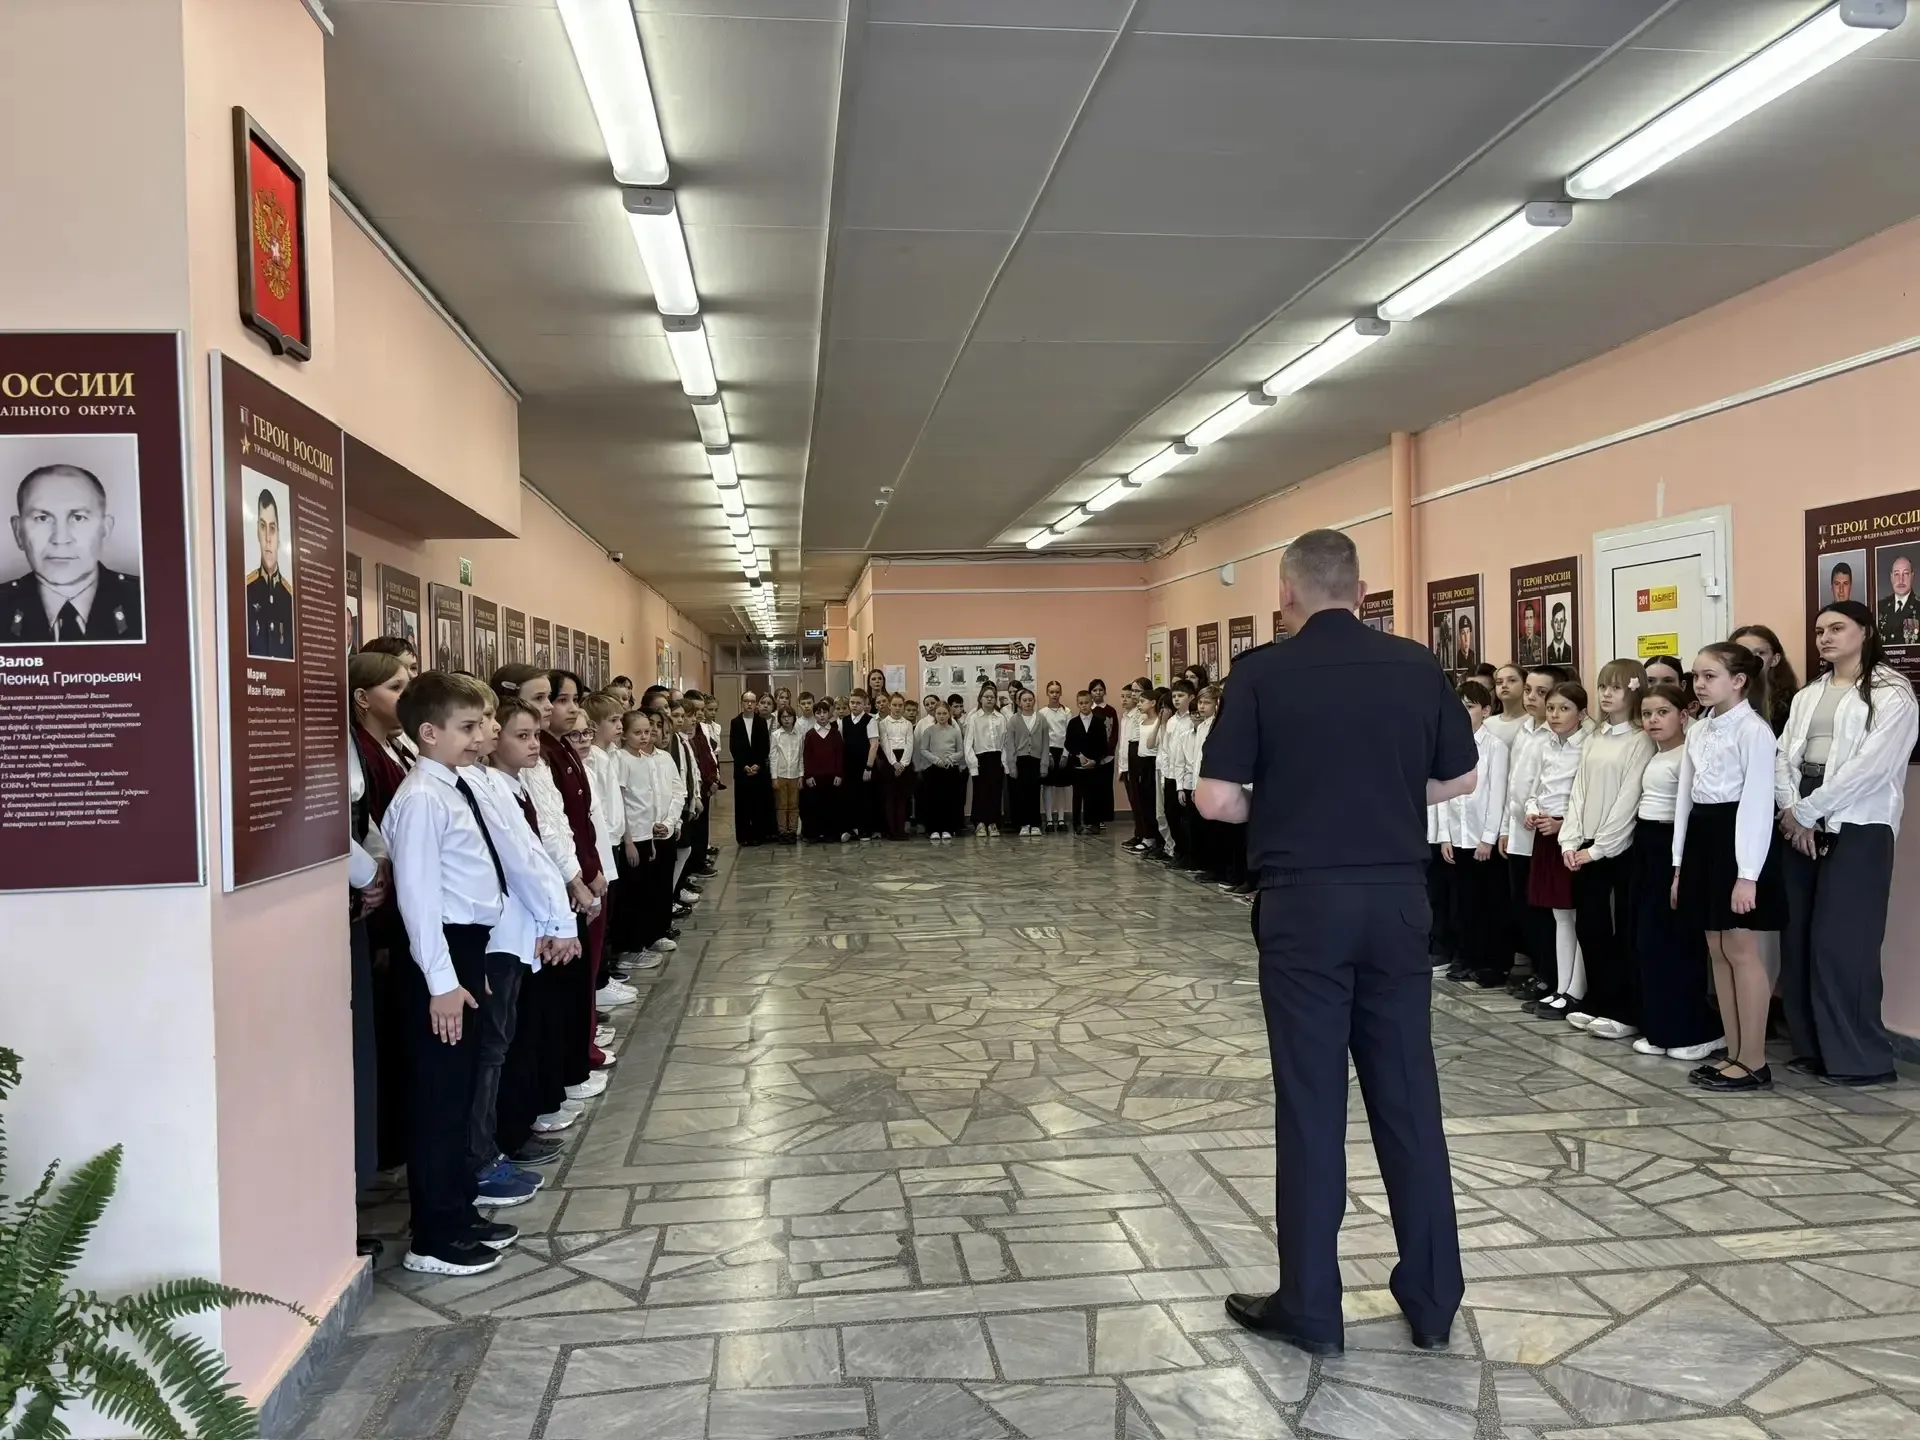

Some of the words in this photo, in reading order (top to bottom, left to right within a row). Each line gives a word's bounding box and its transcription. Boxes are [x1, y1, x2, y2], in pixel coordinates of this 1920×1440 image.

[0, 372, 136, 398] ОССИИ
[0, 406, 70, 416] АЛЬНОГО
[78, 405, 136, 416] ОКРУГА
[253, 414, 290, 452] ГЕРОИ
[293, 436, 334, 476] РОССИИ
[254, 444, 284, 466] УРАЛЬСКОГО
[286, 460, 318, 482] ФЕДЕРАЛЬНОГО
[1830, 519, 1868, 536] ГЕРОИ
[1830, 536, 1862, 544] УРАЛЬСКОГО
[1864, 530, 1904, 540] ФЕДЕРАЛЬНОГО
[1523, 576, 1542, 587] ГЕРОИ
[1544, 570, 1570, 584] РОССИИ
[1639, 595, 1648, 606] 201
[1652, 592, 1674, 603] КАБИНЕТ
[0, 673, 50, 686] Леонид
[54, 672, 142, 687] Григорьевич
[247, 668, 266, 682] Марин
[248, 684, 262, 696] Иван
[262, 684, 286, 699] Петрович
